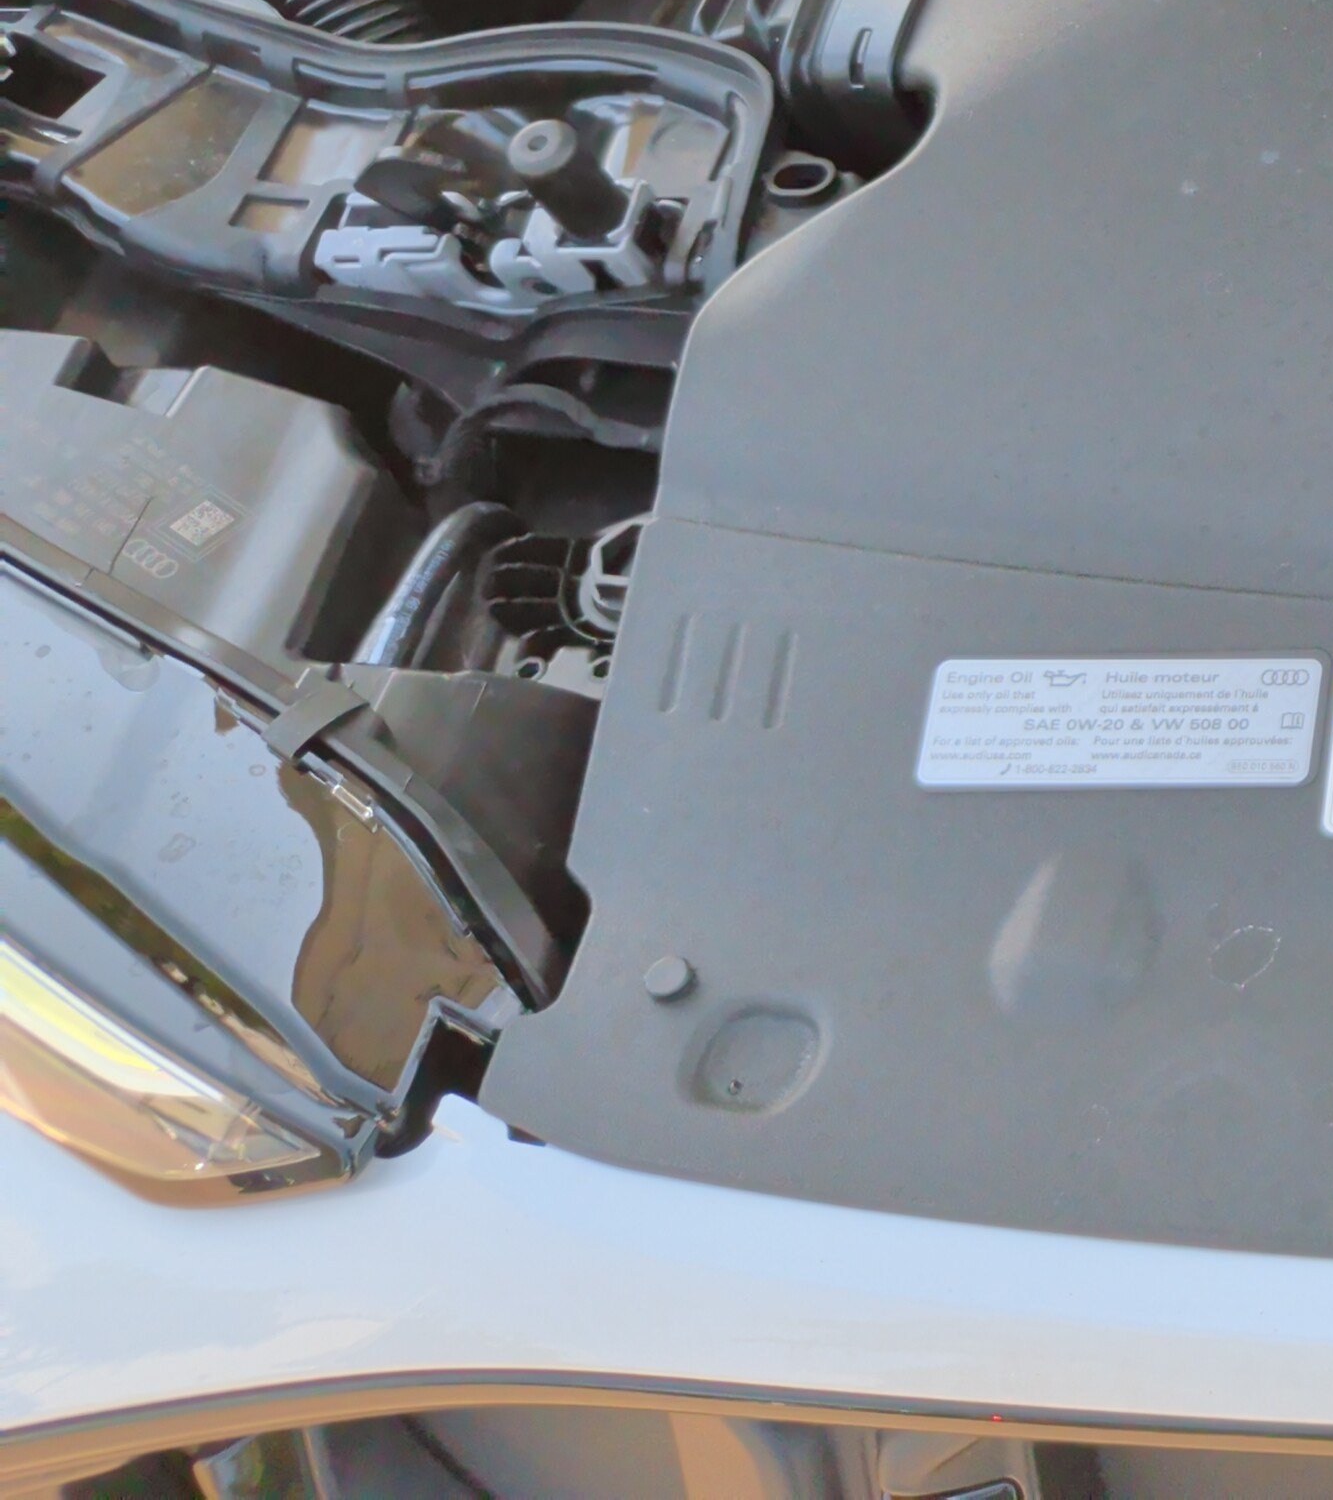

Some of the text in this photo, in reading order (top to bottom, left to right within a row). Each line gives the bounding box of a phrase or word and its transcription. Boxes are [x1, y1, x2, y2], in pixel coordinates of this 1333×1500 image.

[946, 671, 1033, 685] Engine Oil
[1105, 671, 1219, 683] Huile moteur
[941, 690, 1035, 701] Use only oil that
[1101, 689, 1269, 701] Utilisez uniquement de l'huile
[940, 703, 1072, 715] expressly complies with
[1099, 703, 1259, 714] qui satisfait expressément à
[1023, 719, 1249, 730] SAE 0W-20 & VW 508 00
[933, 736, 1080, 747] For a list of approved oils:
[1094, 736, 1119, 746] Pour
[1148, 736, 1172, 745] liste
[1175, 736, 1220, 745] d'huiles
[1223, 736, 1293, 747] approuvées:
